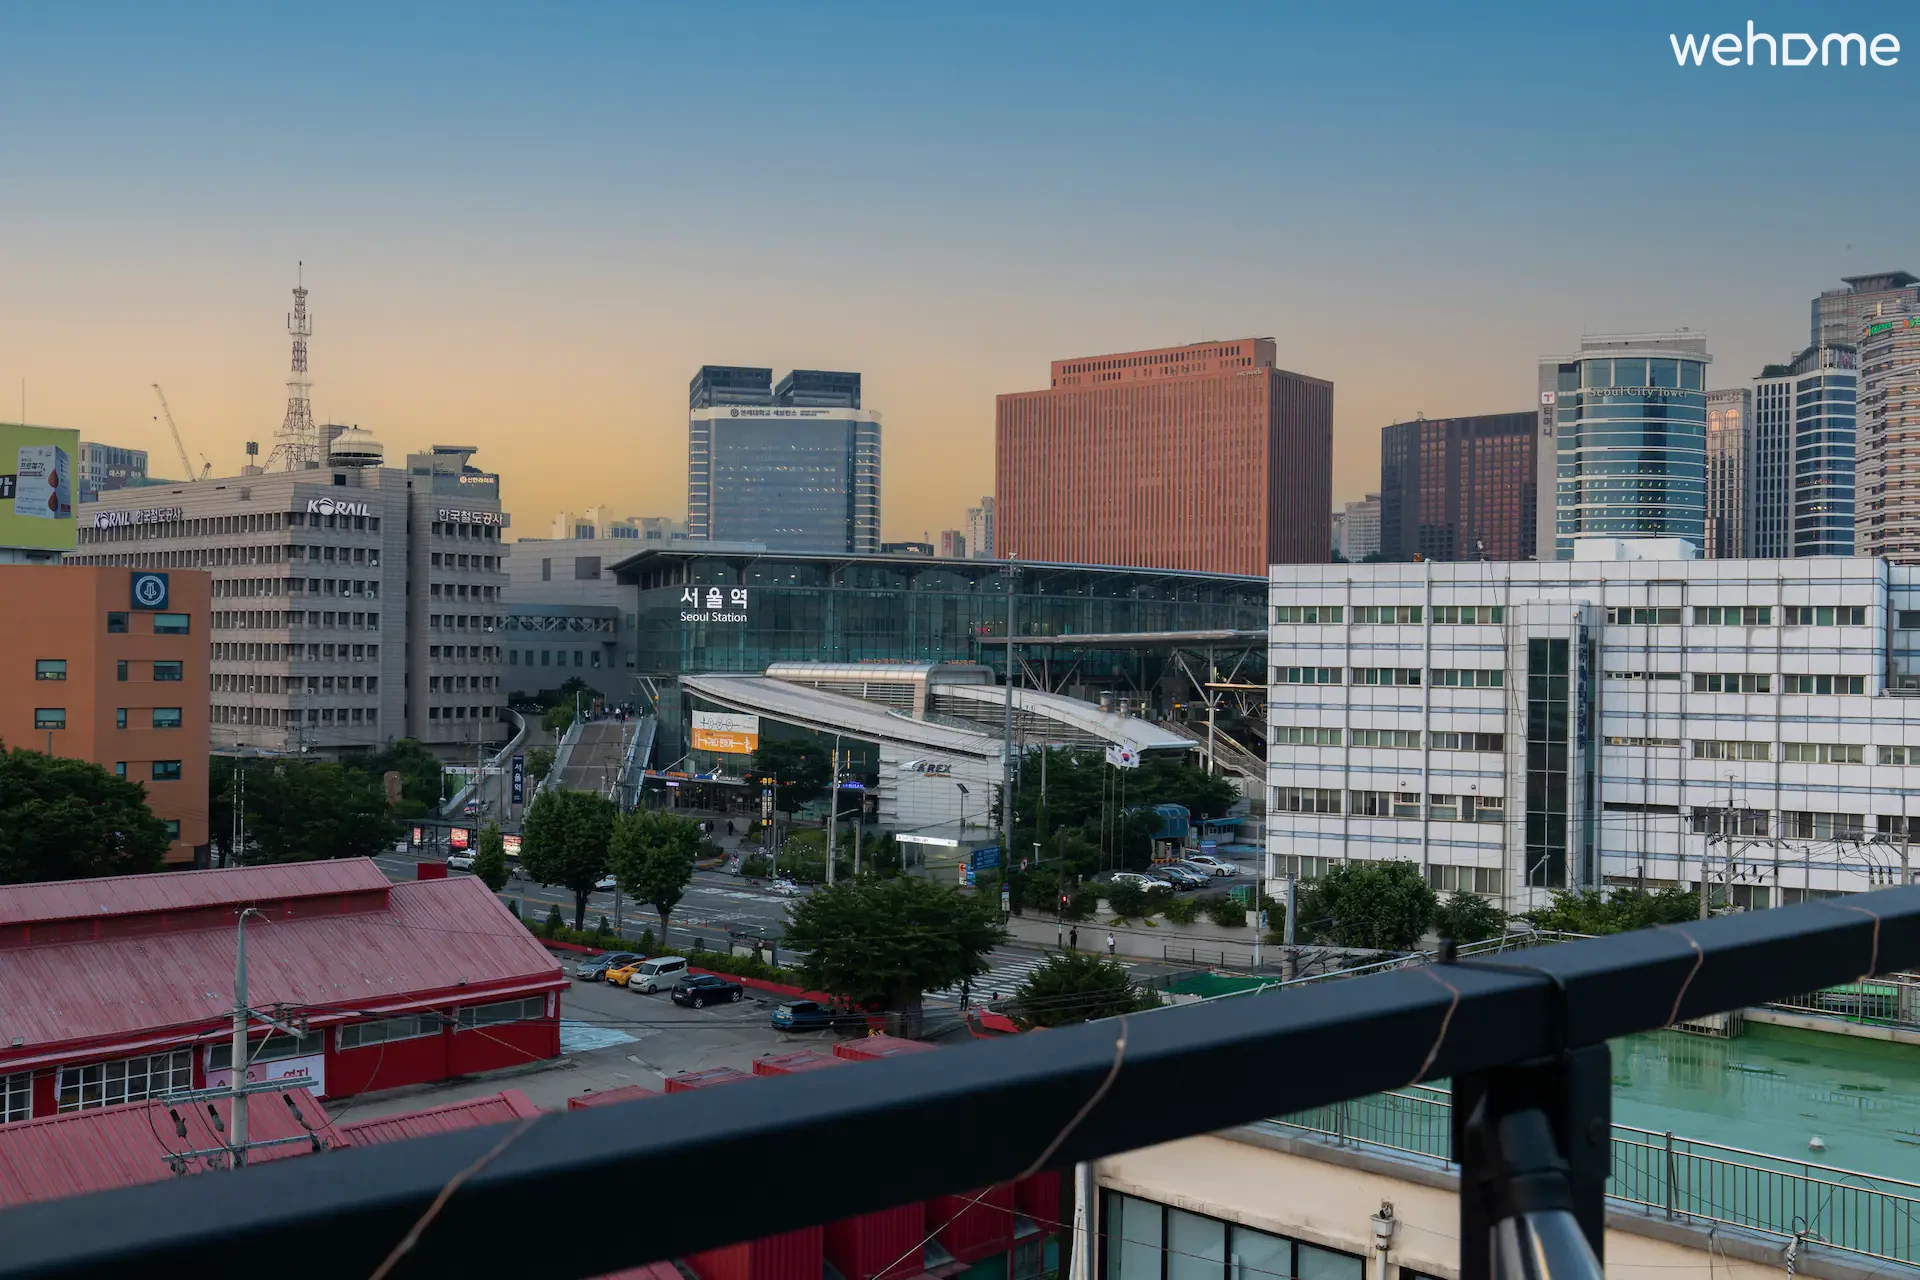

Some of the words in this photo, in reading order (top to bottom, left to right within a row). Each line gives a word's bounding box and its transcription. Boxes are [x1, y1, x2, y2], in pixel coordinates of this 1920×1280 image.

[1588, 386, 1624, 397] Seoul
[1626, 386, 1654, 398] City
[1658, 387, 1688, 398] Tower
[307, 498, 371, 517] KORAIL
[438, 508, 504, 526] 한국철도공사
[94, 510, 130, 530] KORAIL
[135, 507, 183, 525] 한국철도공사
[680, 587, 748, 610] 서울역
[680, 611, 709, 622] Seoul
[711, 611, 748, 623] Station
[514, 763, 522, 792] 서울역
